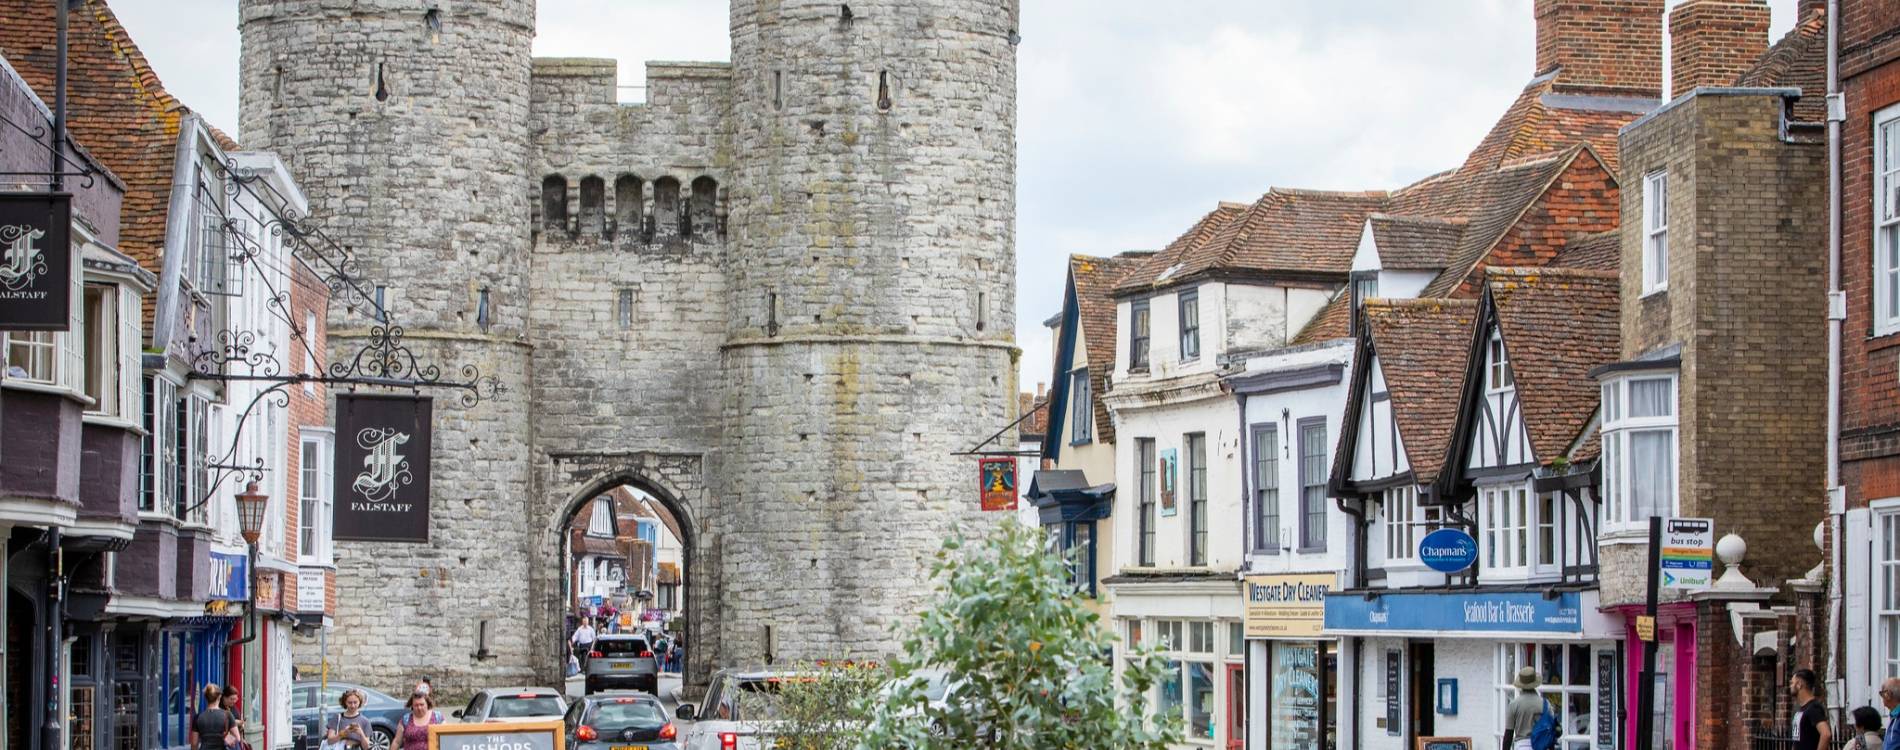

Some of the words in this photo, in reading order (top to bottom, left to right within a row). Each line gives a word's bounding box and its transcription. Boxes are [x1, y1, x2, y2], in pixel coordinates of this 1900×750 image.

[0, 291, 47, 299] ALSTAFF
[351, 502, 412, 512] FALSTAFF
[1671, 537, 1684, 545] bus
[1686, 539, 1703, 547] stop
[1464, 601, 1487, 623] Seafood
[1488, 601, 1498, 623] Bar
[1506, 601, 1535, 623] Brasserie
[486, 735, 506, 743] THE
